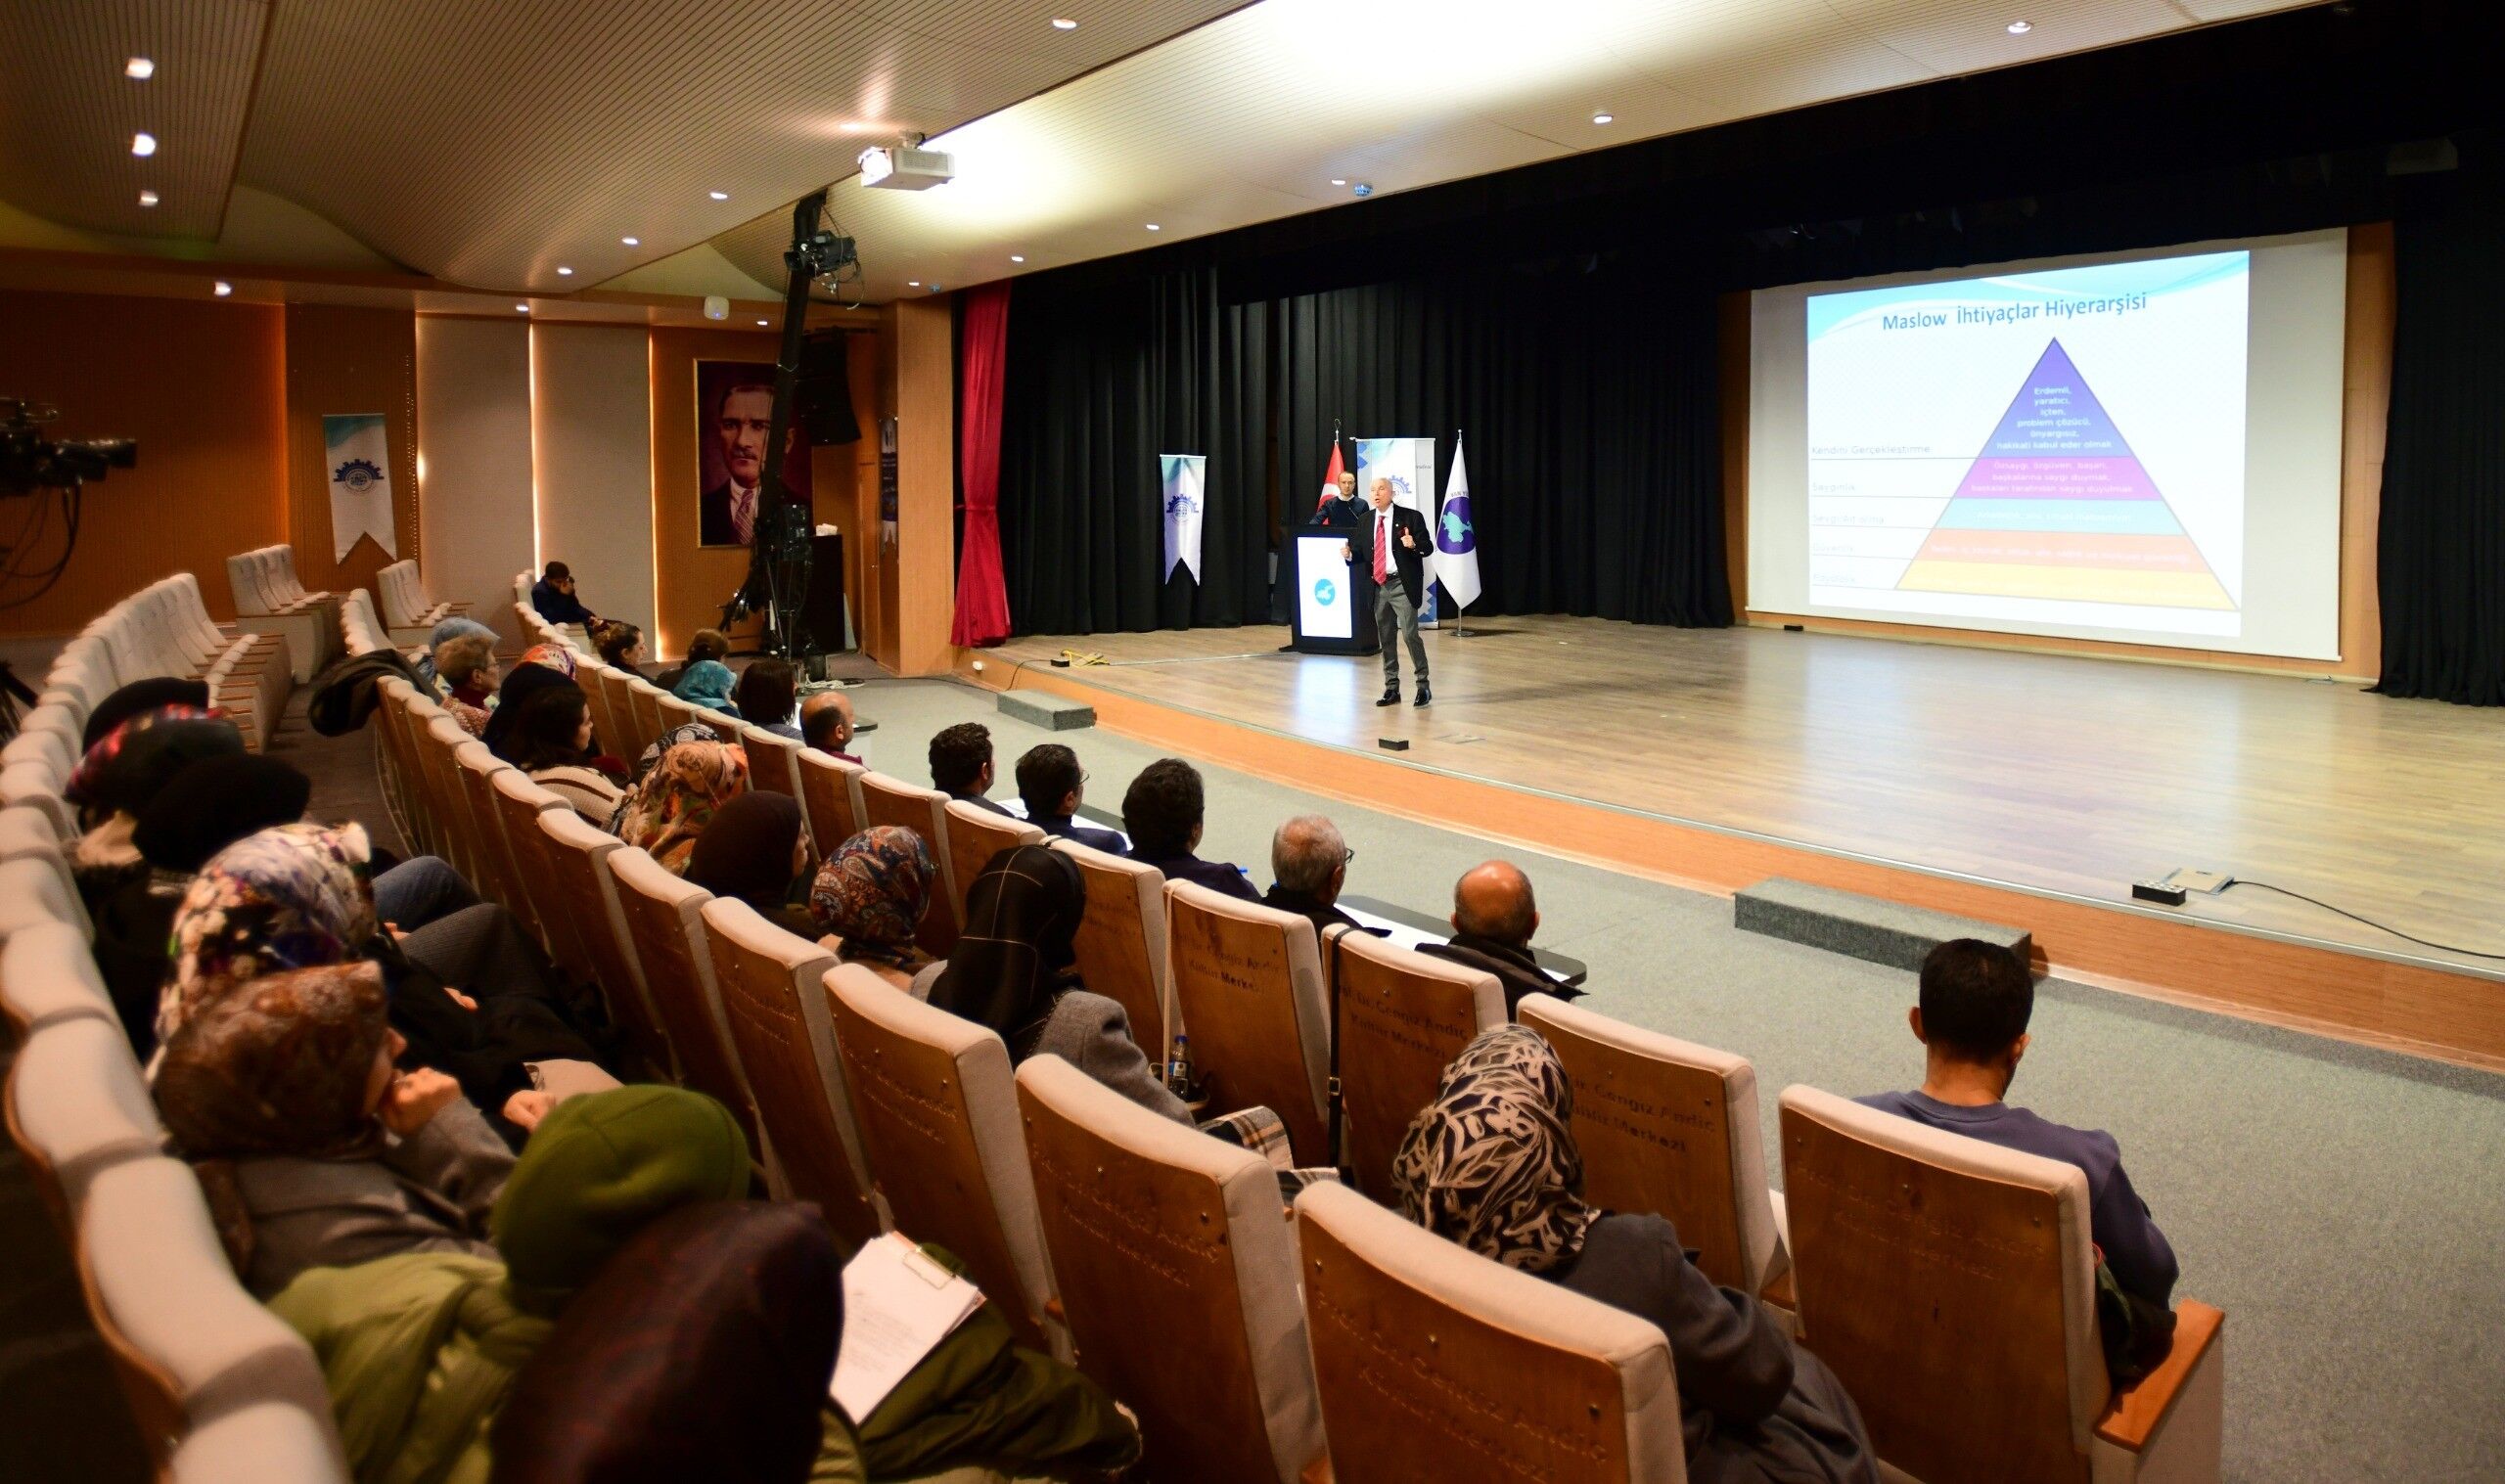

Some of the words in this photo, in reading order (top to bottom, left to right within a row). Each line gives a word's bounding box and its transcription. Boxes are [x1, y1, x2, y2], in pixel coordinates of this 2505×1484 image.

[1883, 311, 1947, 331] Maslow
[1957, 301, 2040, 325] İhtiyaçlar
[2046, 292, 2148, 319] Hiyerarşisi
